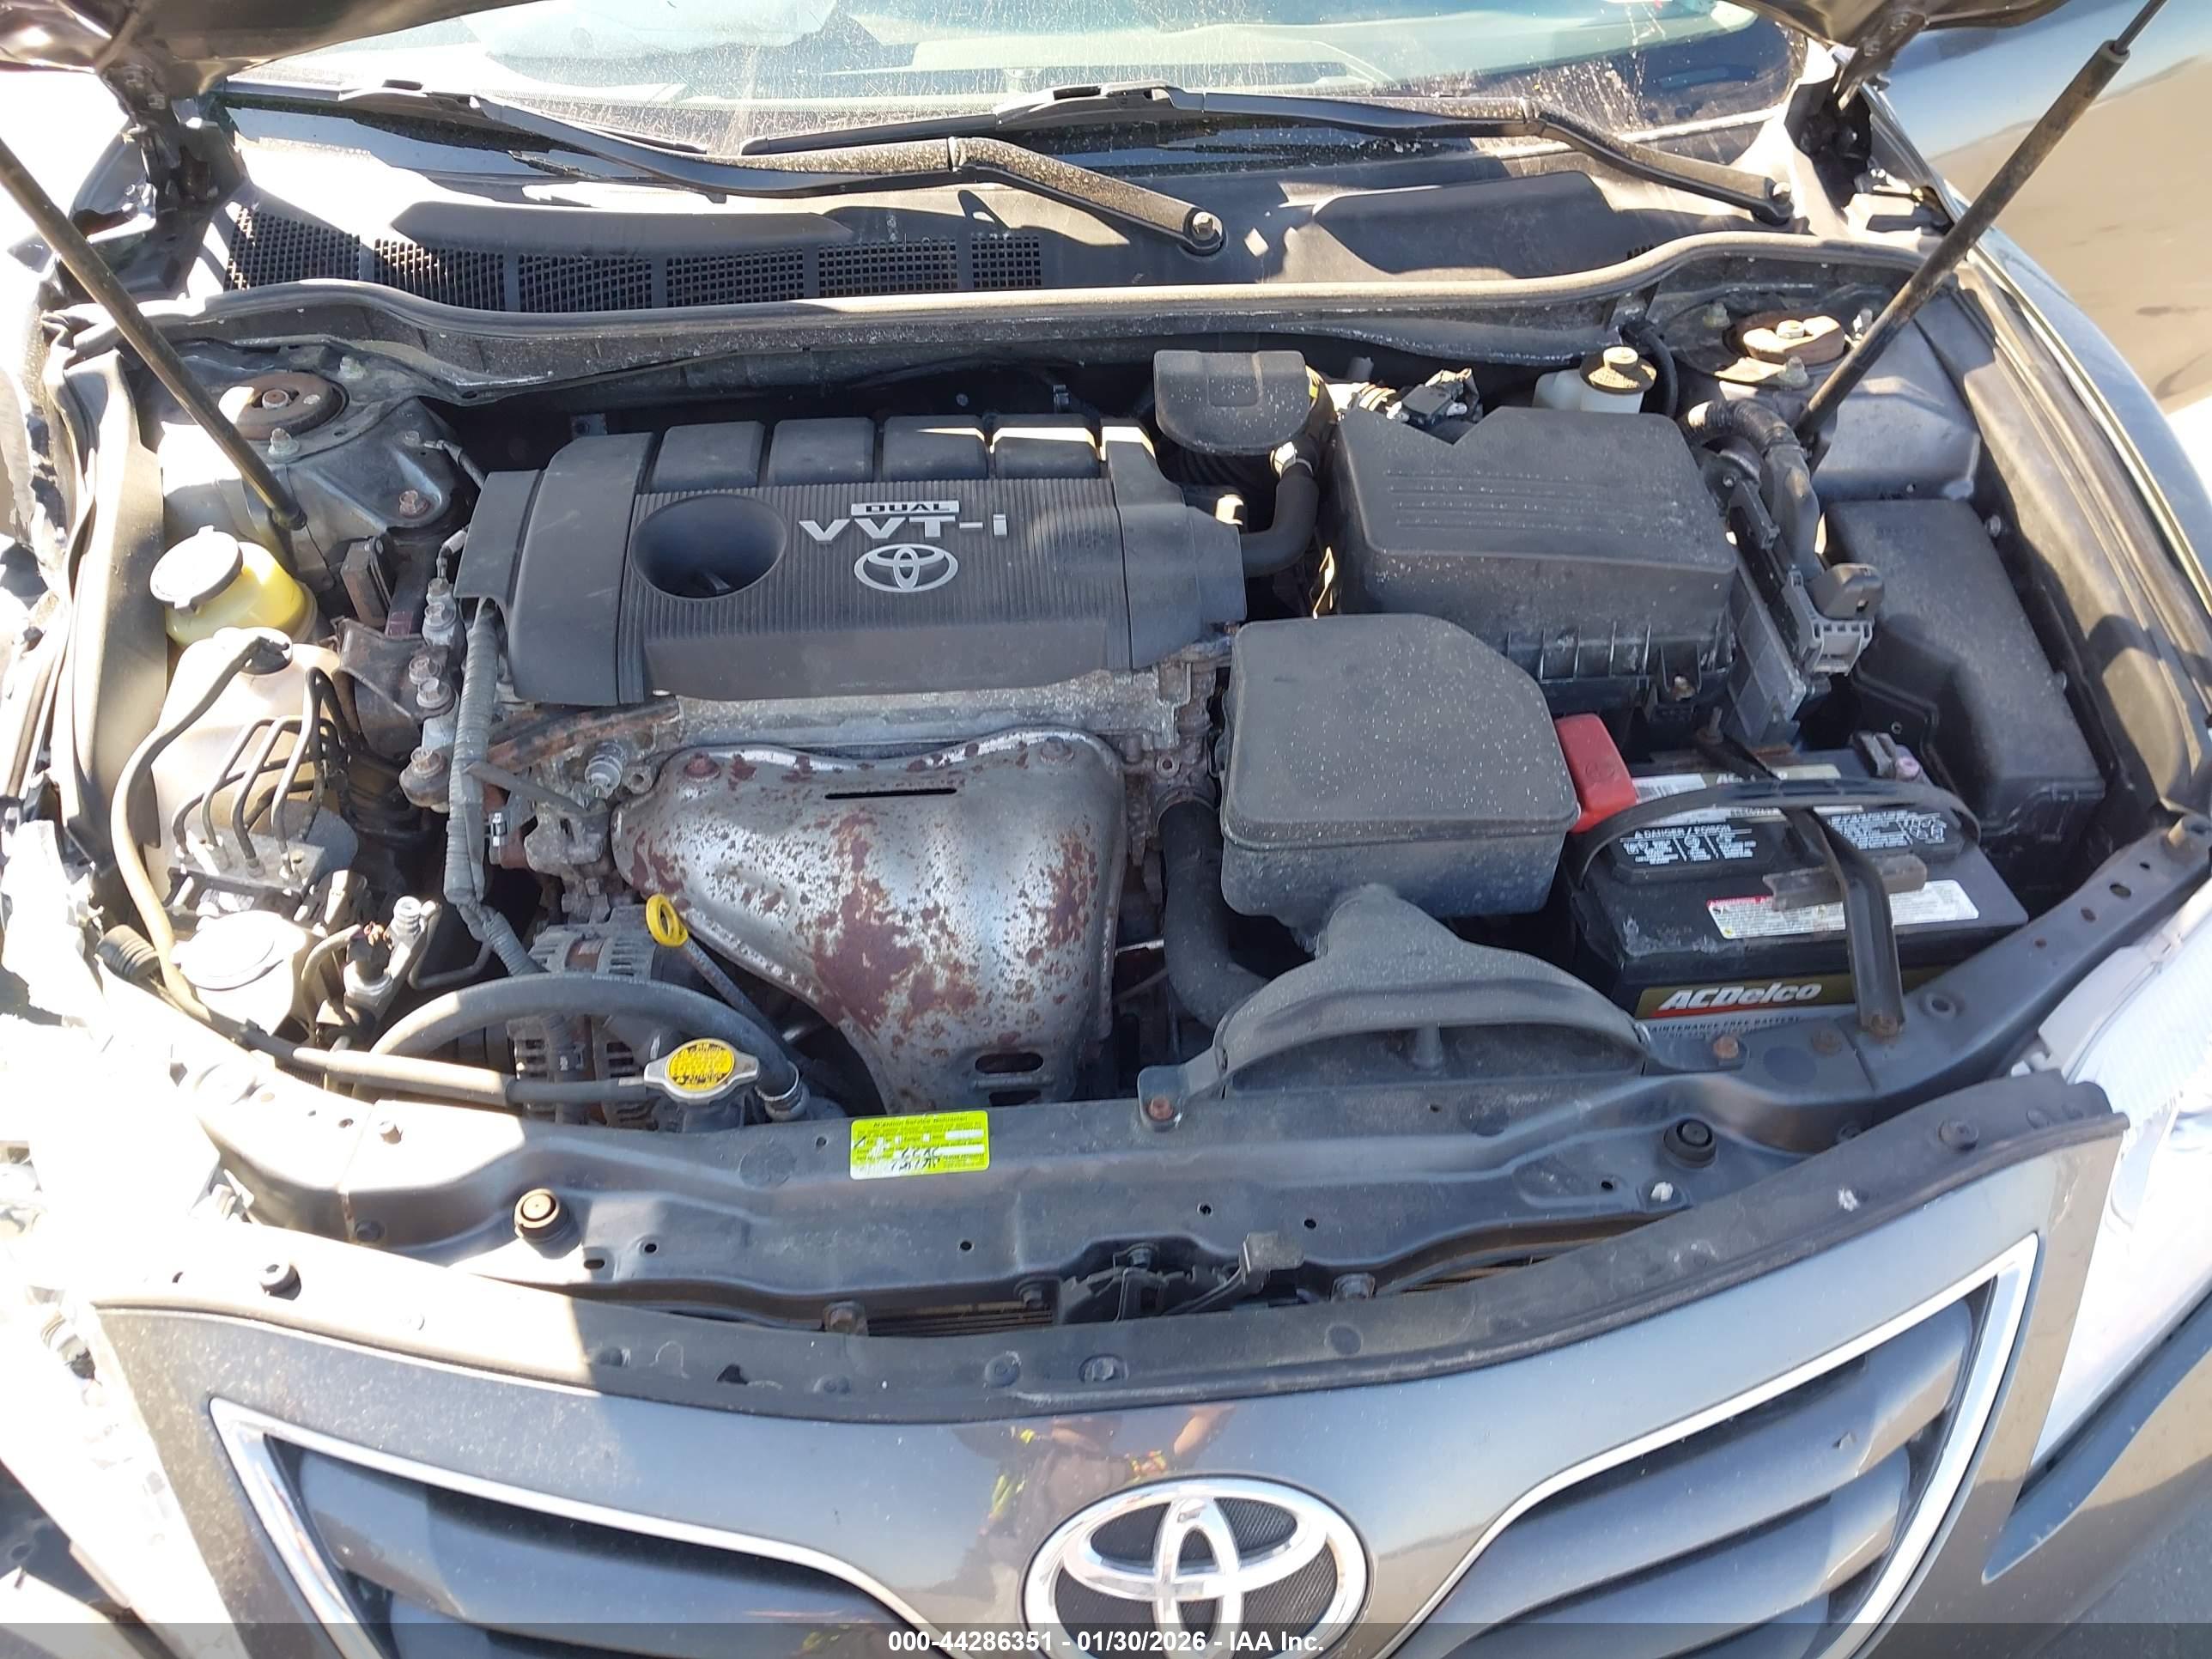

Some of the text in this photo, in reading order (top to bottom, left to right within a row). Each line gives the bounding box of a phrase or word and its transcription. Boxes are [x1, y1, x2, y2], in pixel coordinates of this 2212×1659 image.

[866, 503, 950, 514] DUAL
[799, 514, 1008, 542] VVT-i
[1657, 981, 1822, 1011] ACDelco
